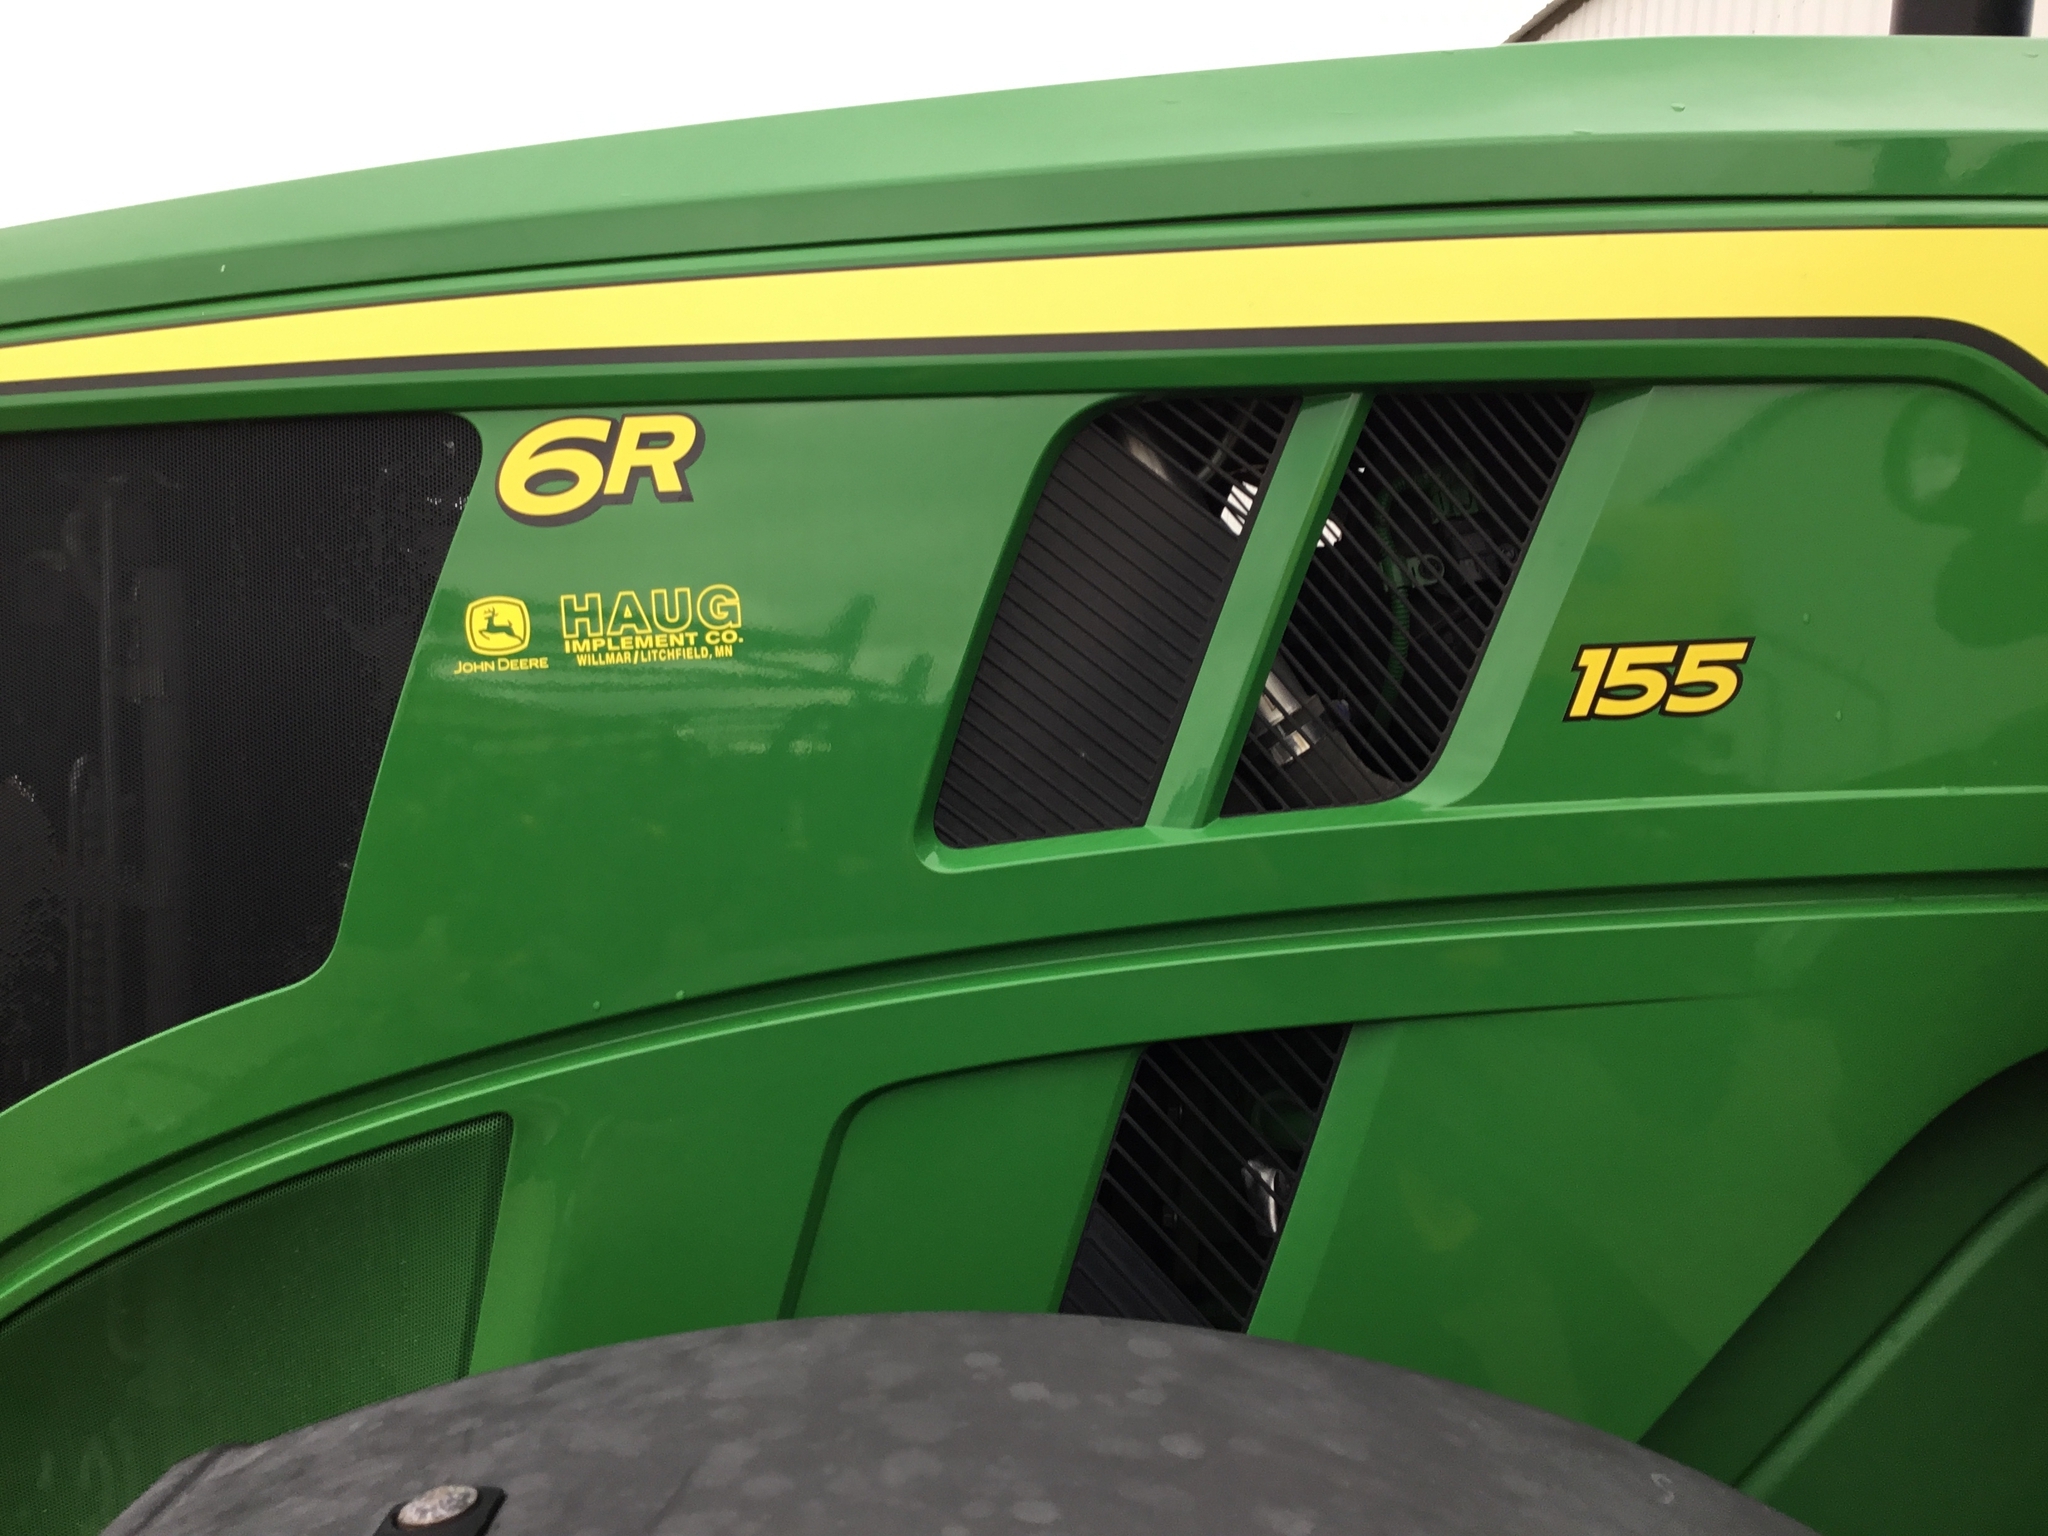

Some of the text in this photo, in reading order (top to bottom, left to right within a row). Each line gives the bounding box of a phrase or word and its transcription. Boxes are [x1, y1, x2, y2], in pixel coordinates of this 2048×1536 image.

[497, 413, 702, 522] 6R
[561, 584, 742, 640] HAUG
[564, 630, 744, 654] IMPLEMENT CO.
[714, 645, 733, 658] MN
[453, 657, 549, 674] JOHN DEERE
[1564, 638, 1753, 720] 155
